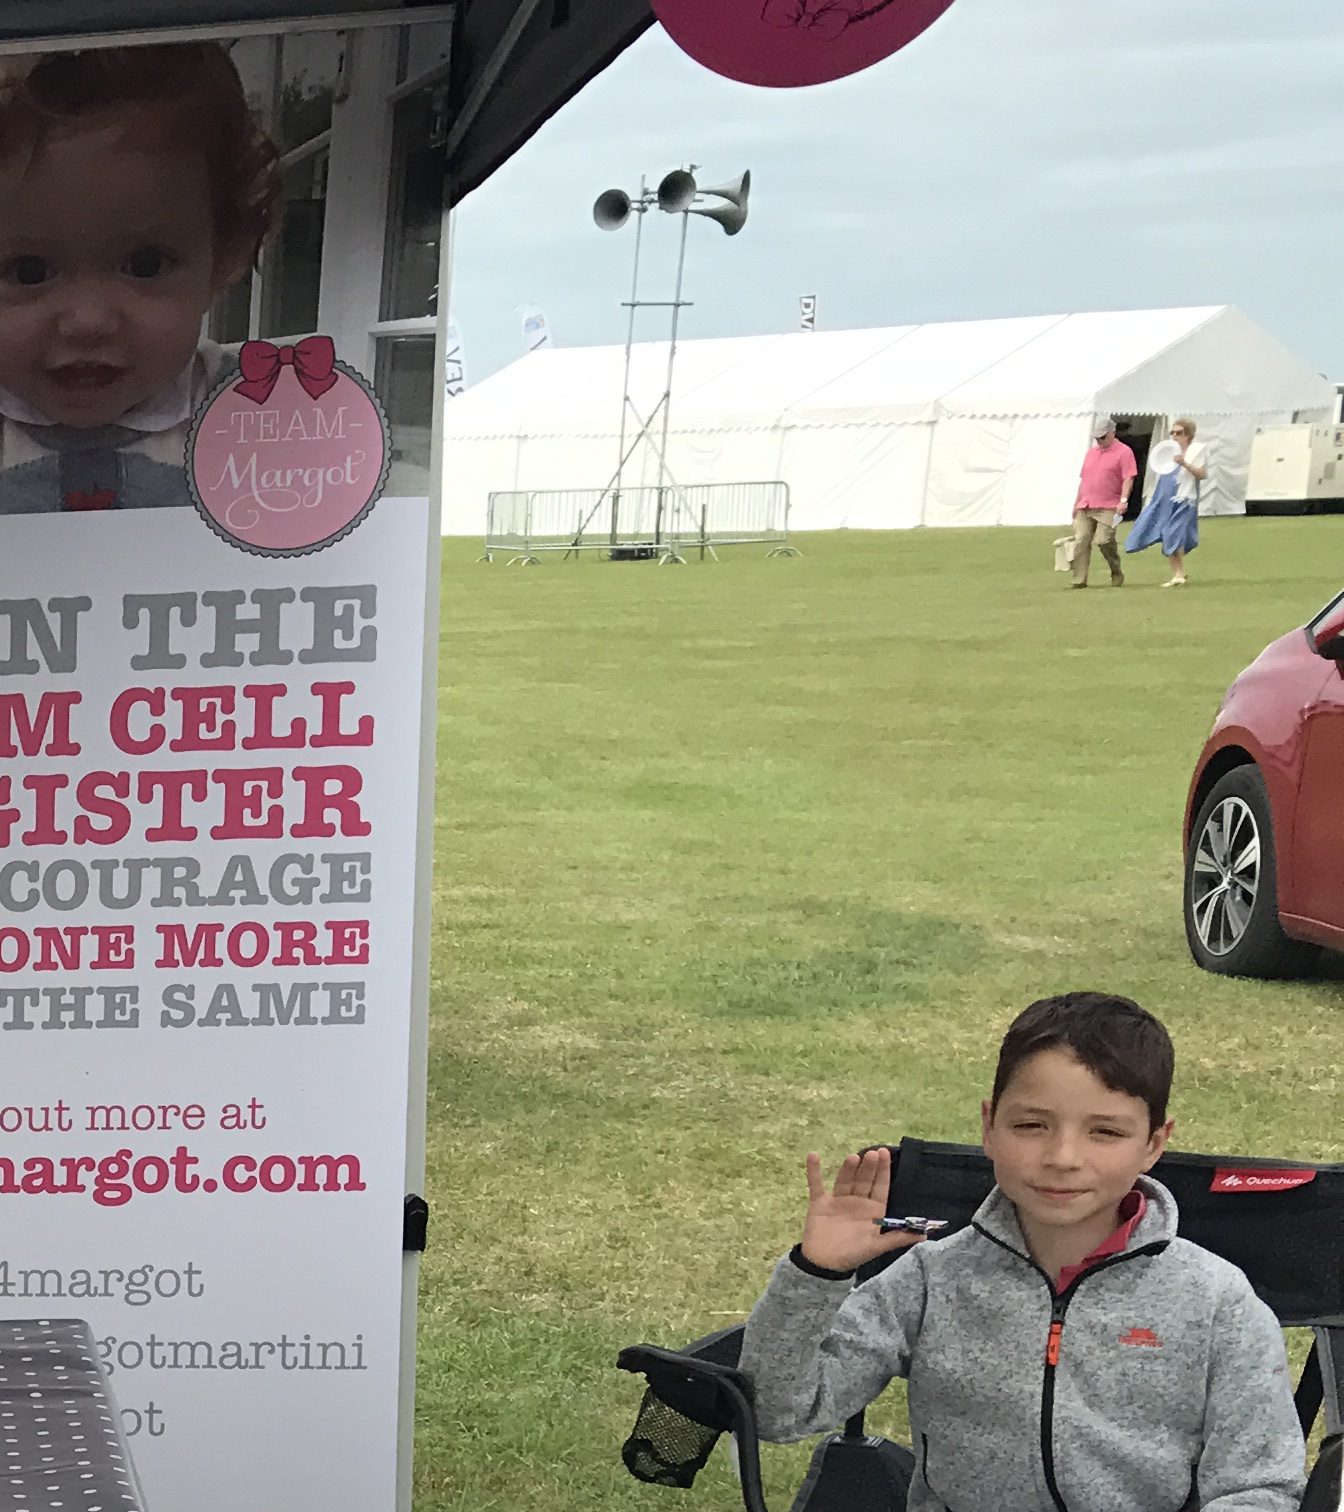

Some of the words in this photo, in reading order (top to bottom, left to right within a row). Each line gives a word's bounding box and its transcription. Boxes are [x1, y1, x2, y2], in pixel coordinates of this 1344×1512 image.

[210, 450, 366, 529] Margot
[122, 584, 378, 671] THE
[109, 681, 374, 755] CELL
[155, 919, 370, 969] MORE
[160, 980, 366, 1029] SAME
[0, 1103, 72, 1132] out
[85, 1103, 205, 1131] more
[219, 1097, 266, 1130] at
